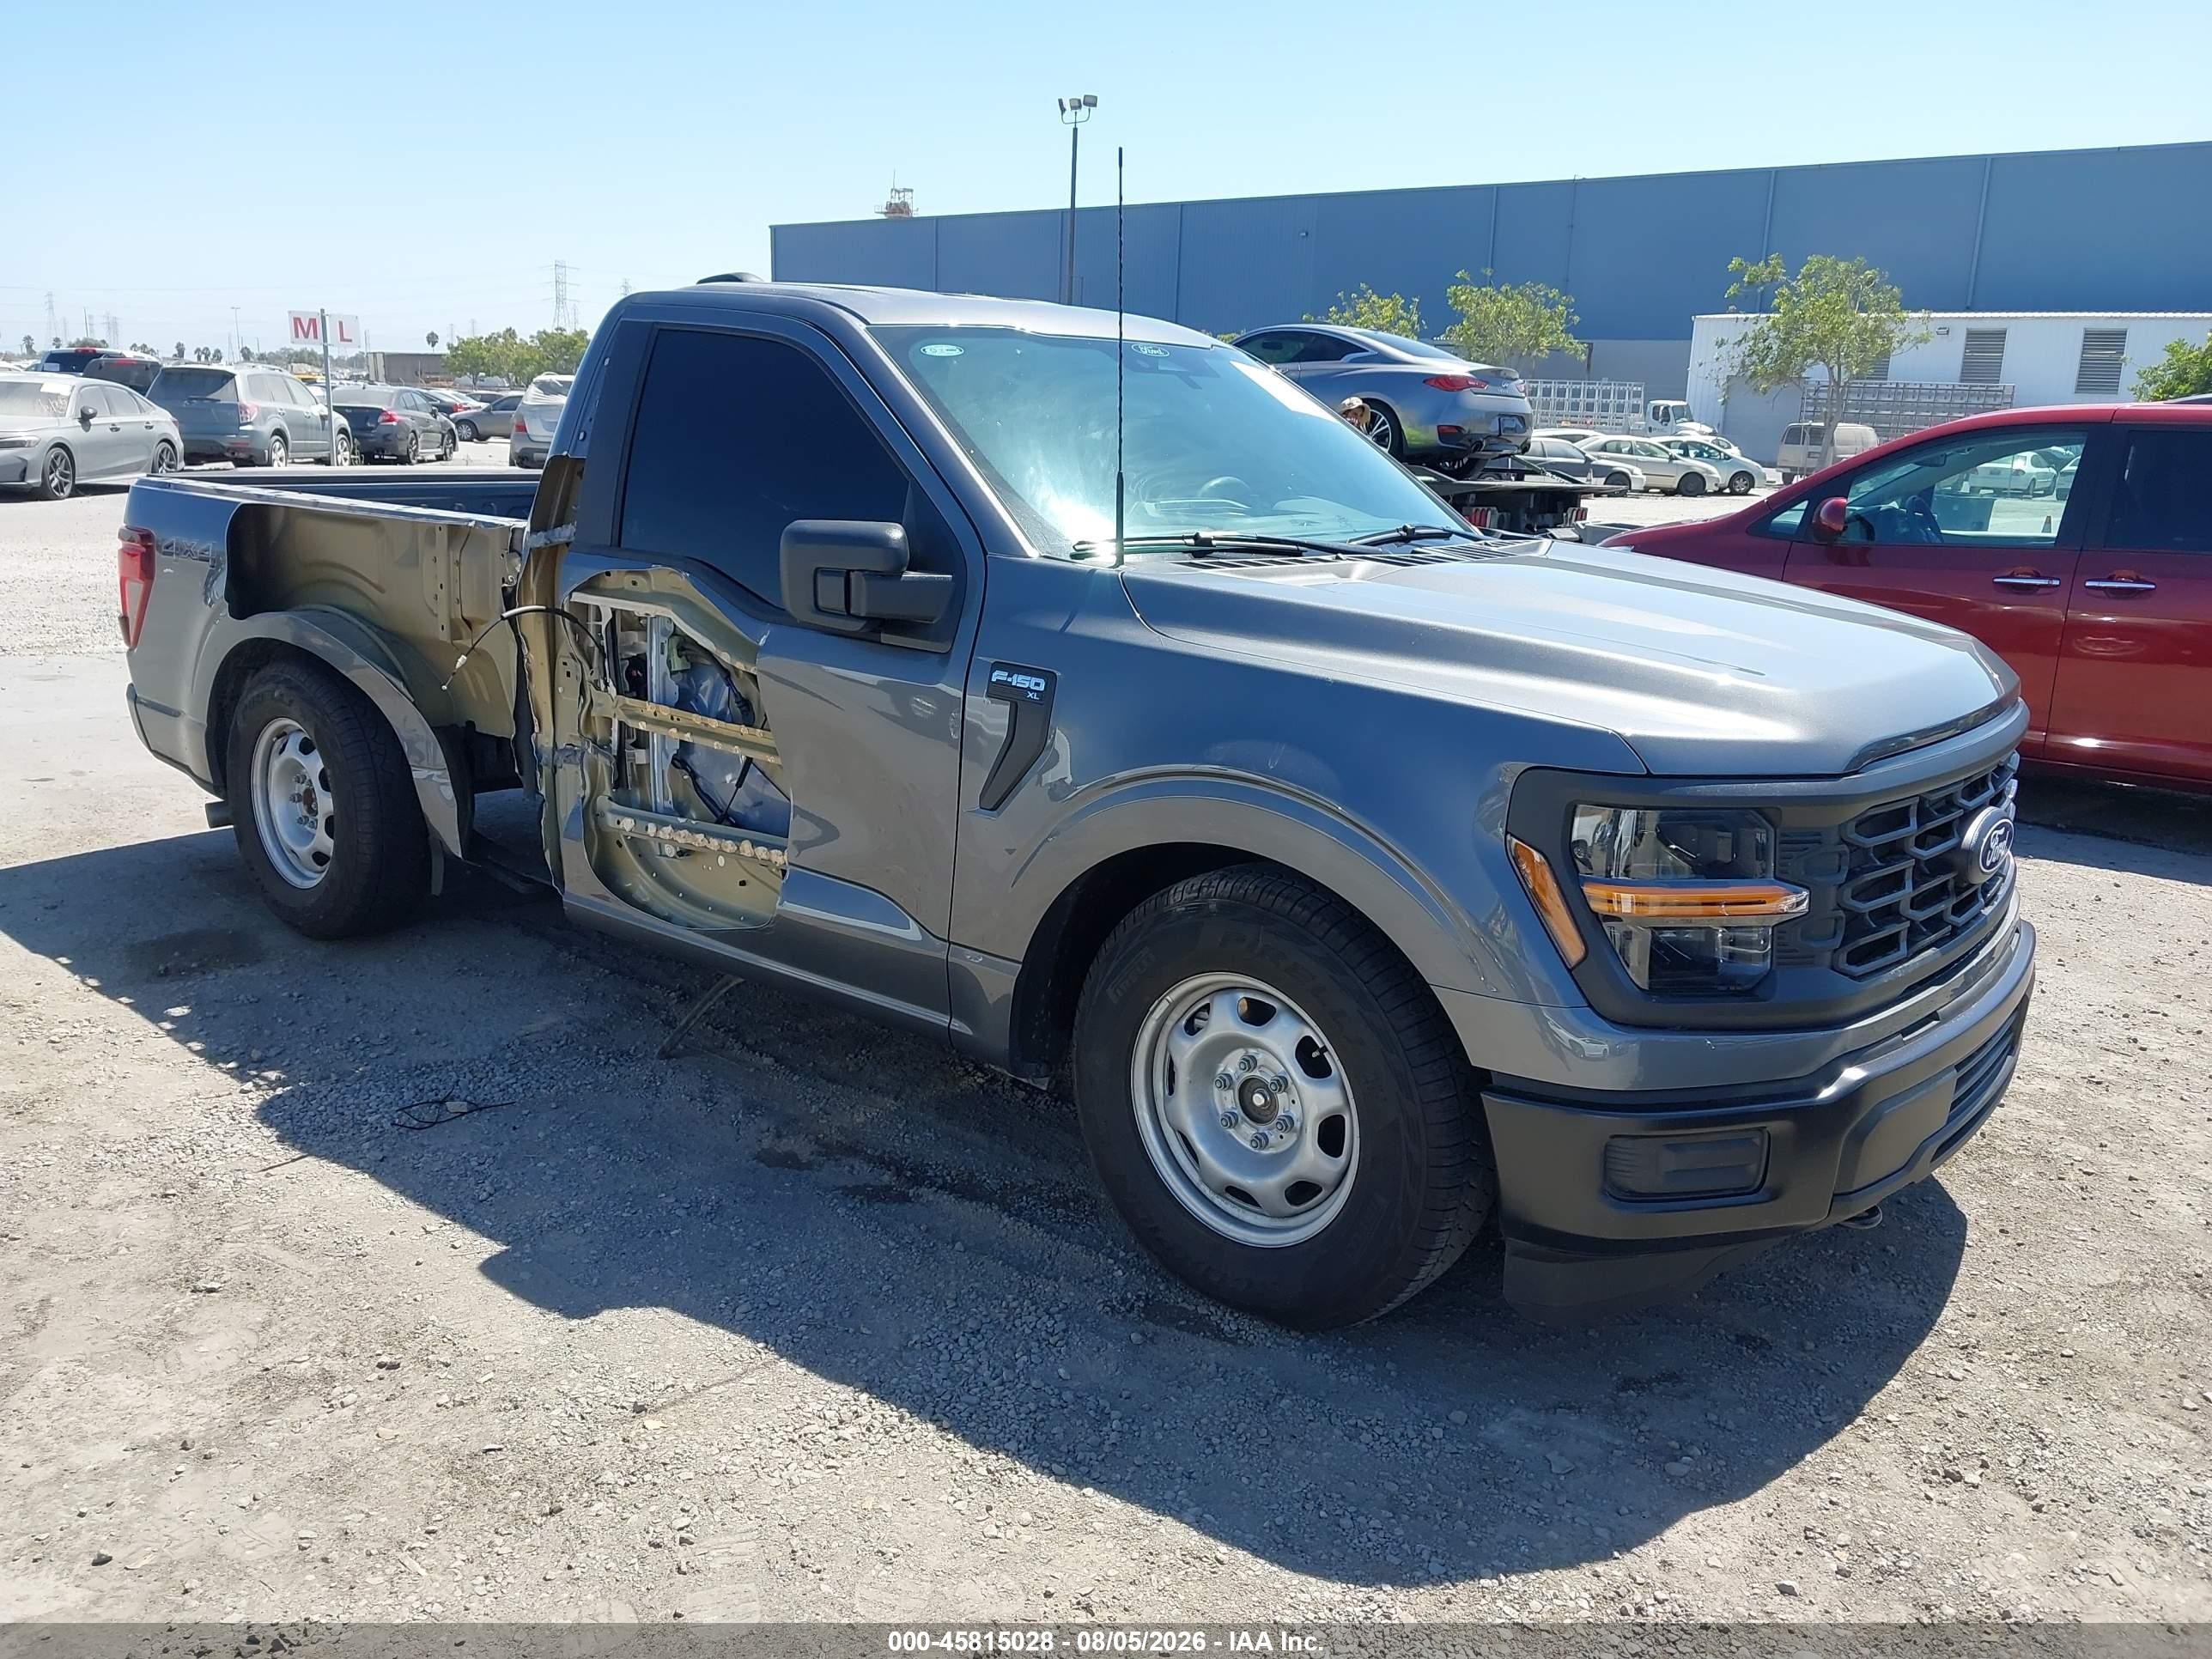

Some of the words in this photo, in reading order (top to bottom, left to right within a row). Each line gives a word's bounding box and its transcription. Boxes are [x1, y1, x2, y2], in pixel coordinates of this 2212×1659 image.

[293, 316, 319, 340] M
[338, 320, 353, 343] L
[991, 669, 1046, 691] F-150
[1026, 690, 1040, 700] XL
[1986, 827, 2010, 866] Ford
